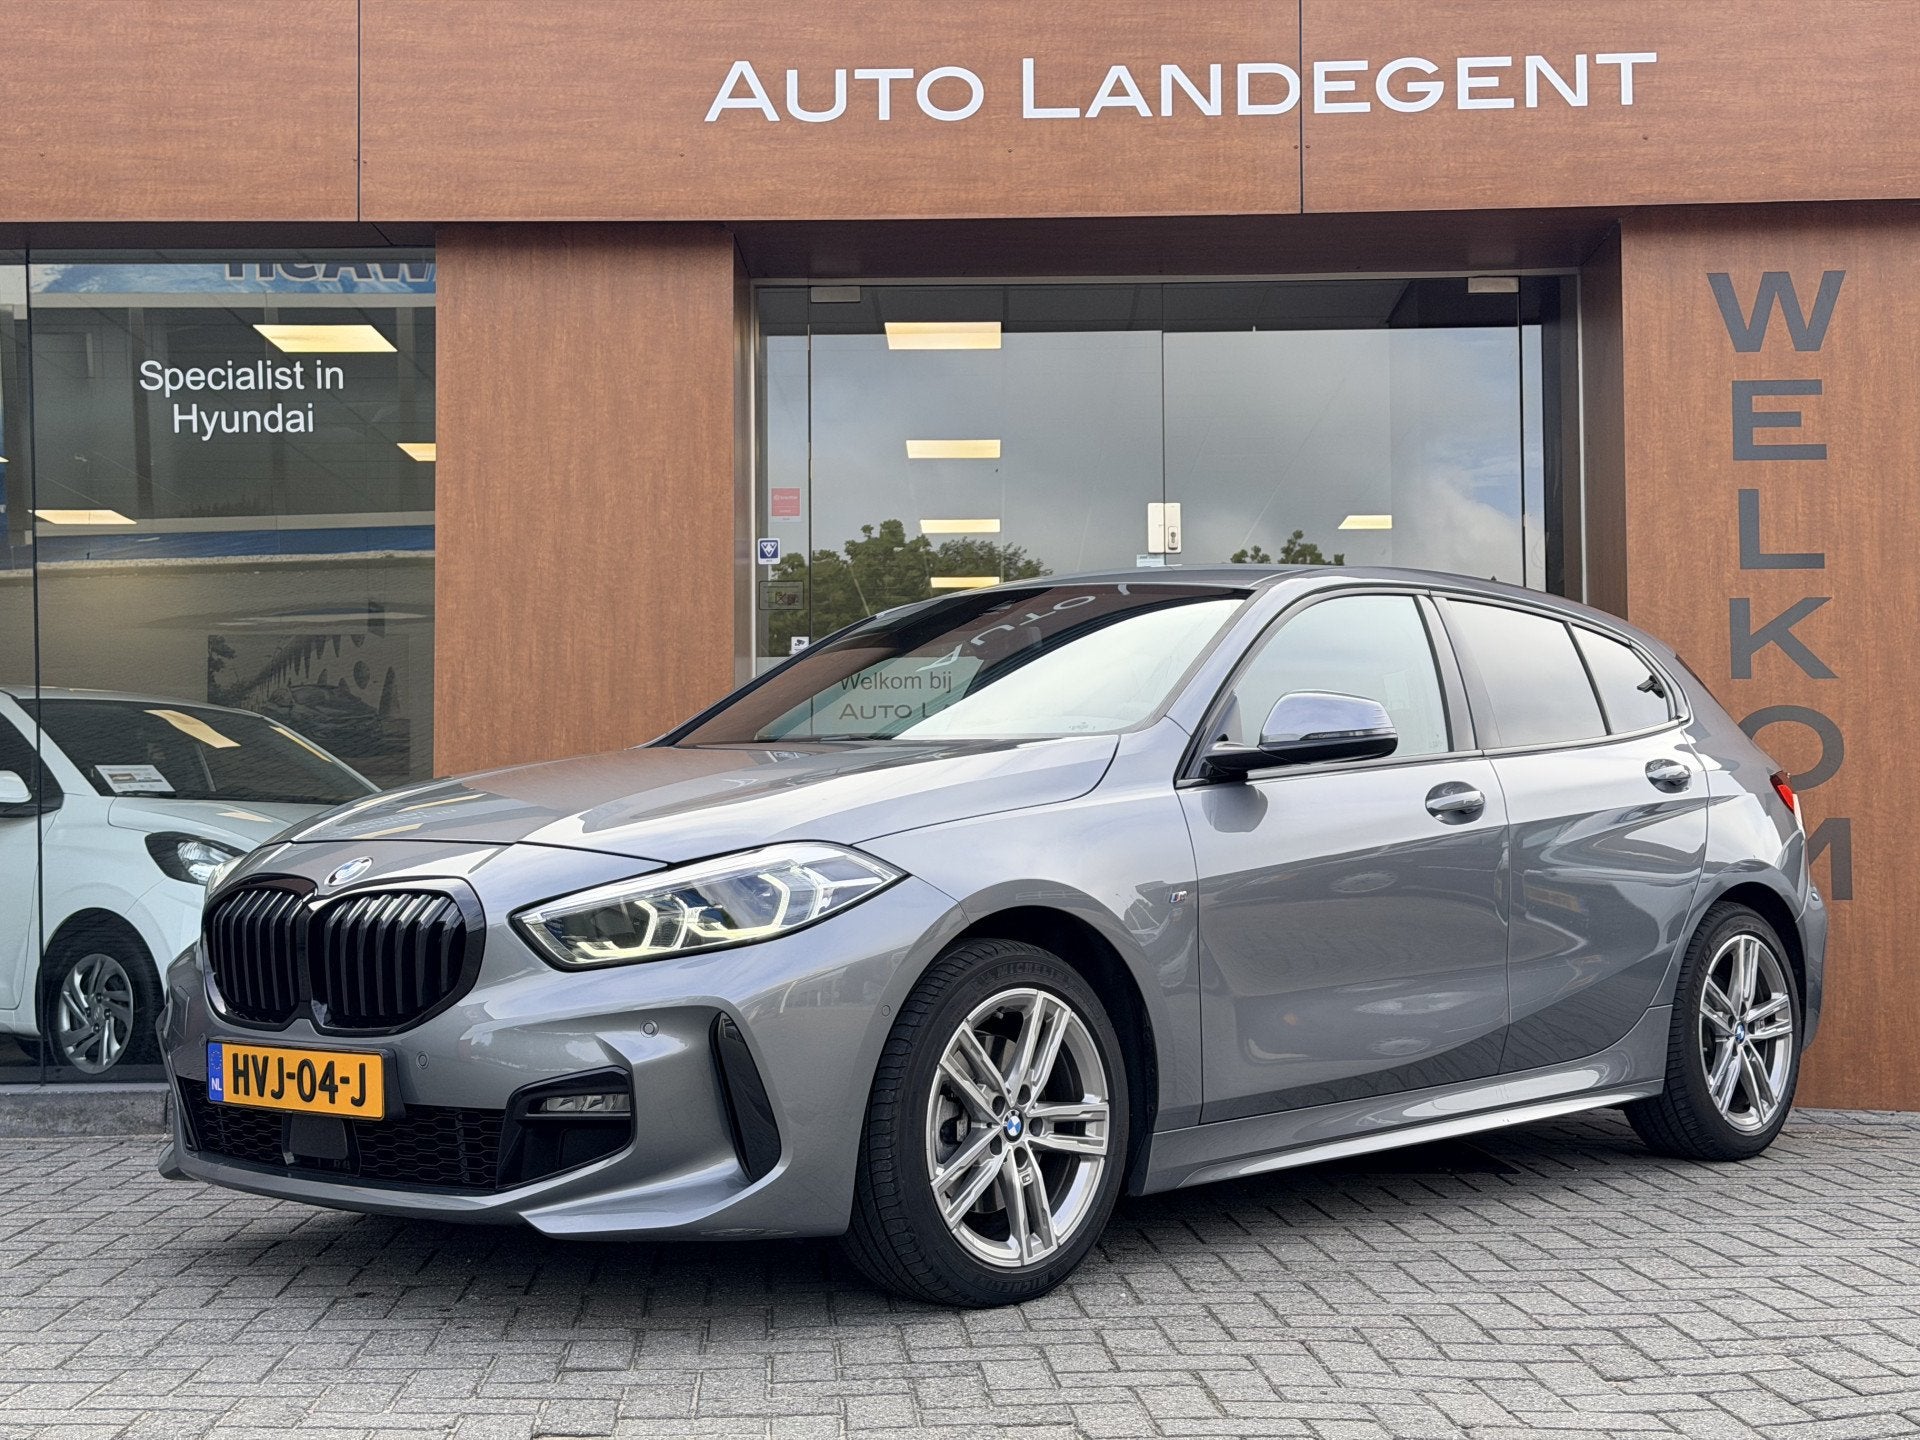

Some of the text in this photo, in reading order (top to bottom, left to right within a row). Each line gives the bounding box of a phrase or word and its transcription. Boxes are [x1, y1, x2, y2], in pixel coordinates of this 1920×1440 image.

[704, 52, 1658, 123] AUTO LANDEGENT
[139, 359, 344, 397] Specialist in
[173, 403, 314, 441] Hyundai
[840, 671, 953, 694] Welkom bij
[838, 703, 914, 720] AUTO
[211, 1077, 223, 1091] NL
[232, 1052, 367, 1107] HVJ-04-J
